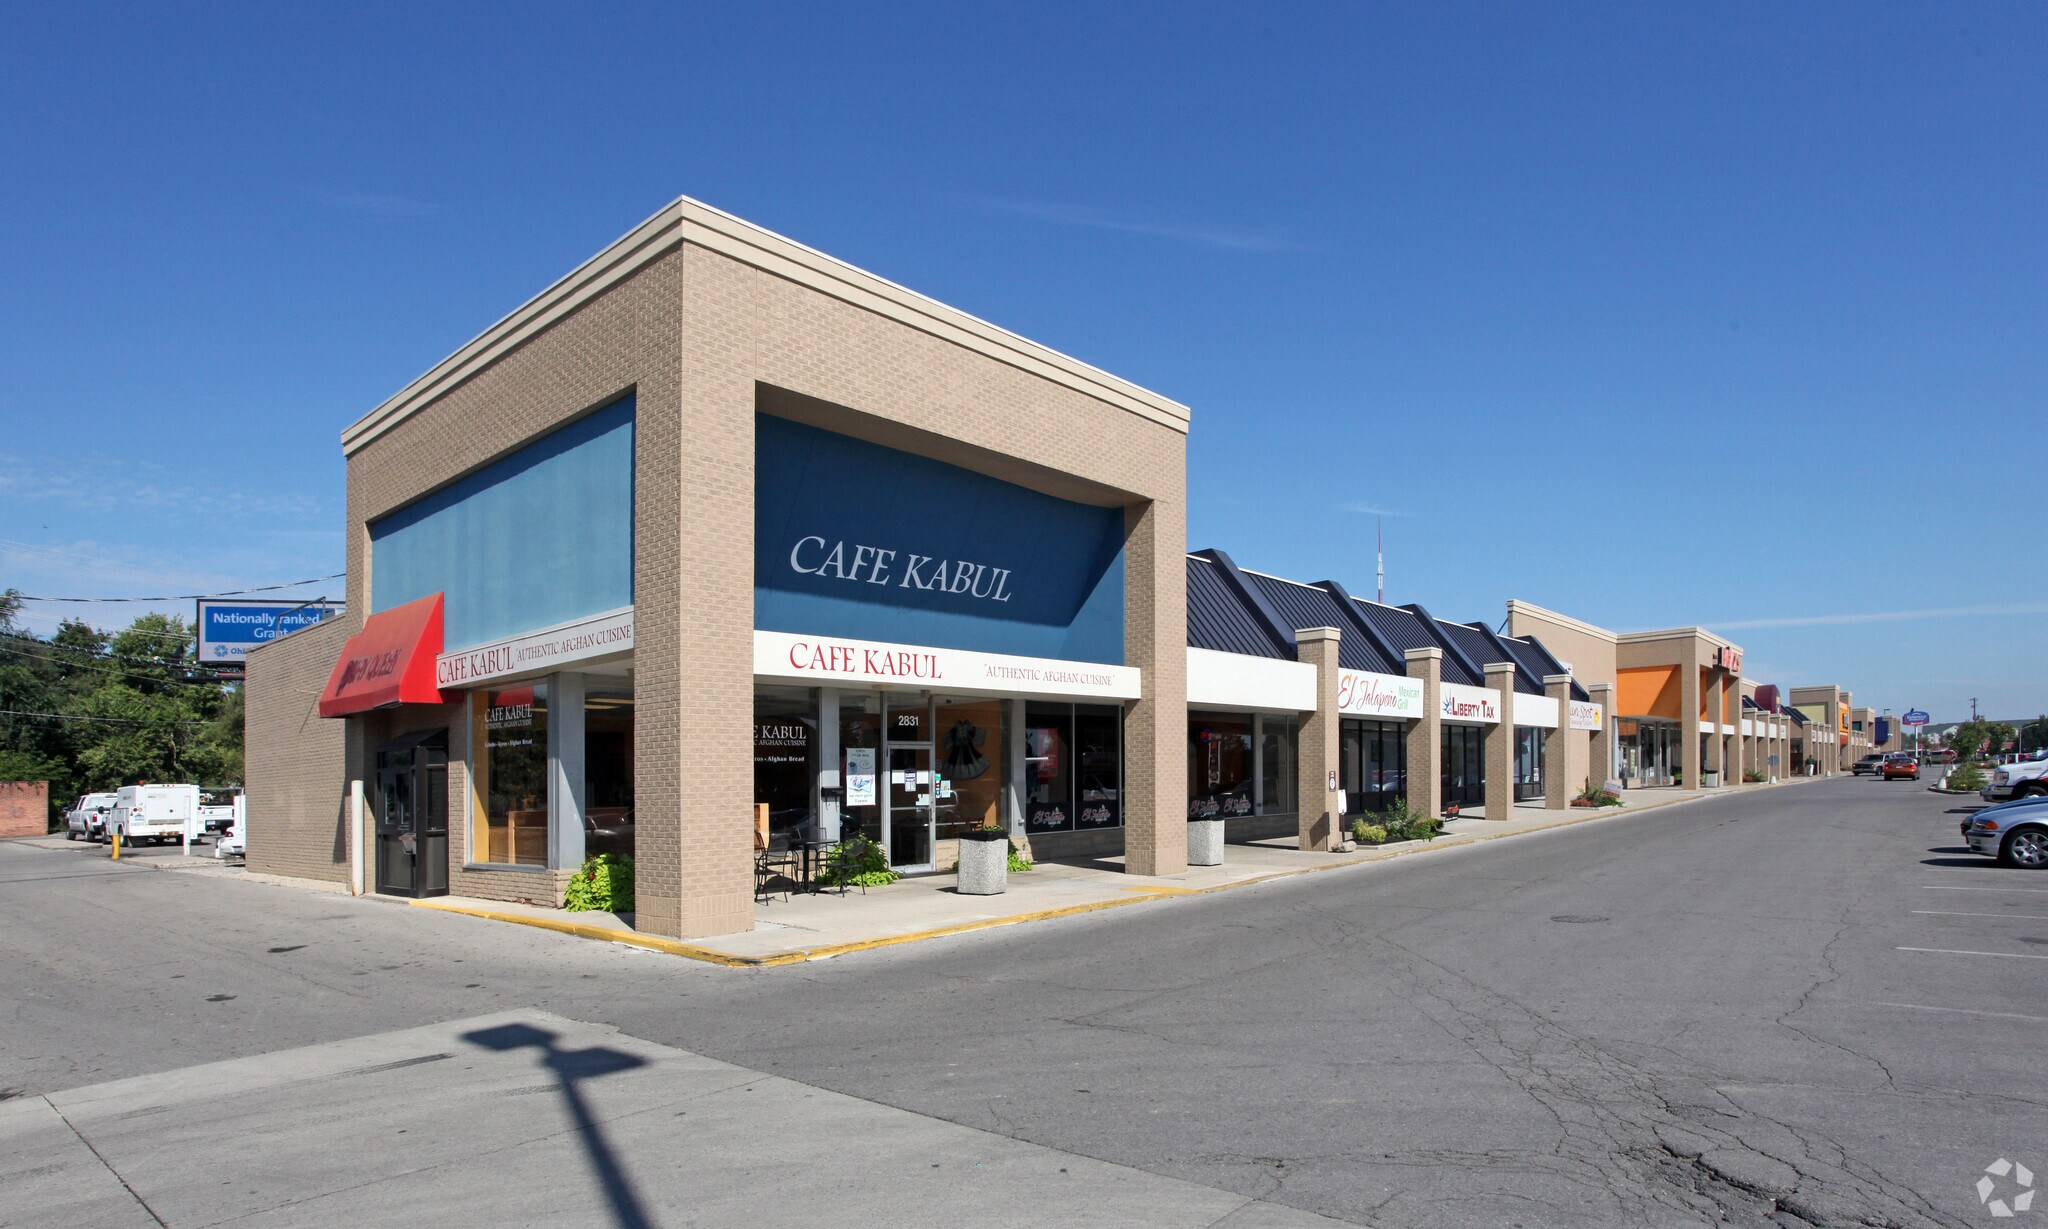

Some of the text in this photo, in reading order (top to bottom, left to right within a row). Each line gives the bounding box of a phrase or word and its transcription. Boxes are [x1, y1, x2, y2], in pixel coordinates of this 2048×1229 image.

[790, 536, 1012, 602] CAFE KABUL
[213, 612, 320, 627] Nationally ranked
[438, 655, 467, 684] CAFE
[470, 646, 515, 678] KABUL
[561, 633, 595, 654] AFGHAN
[789, 643, 943, 679] CAFE KABUL
[1042, 671, 1078, 684] AFGHAN
[1338, 674, 1398, 712] El Jalapeño
[1398, 685, 1420, 699] Mexican
[1397, 699, 1409, 710] Grill
[1452, 696, 1480, 718] LIBERTY
[1570, 706, 1579, 717] un
[484, 703, 533, 723] CAFE KABUL
[898, 715, 919, 726] 2831
[762, 725, 807, 739] KABUL
[783, 739, 807, 747] CUISINE
